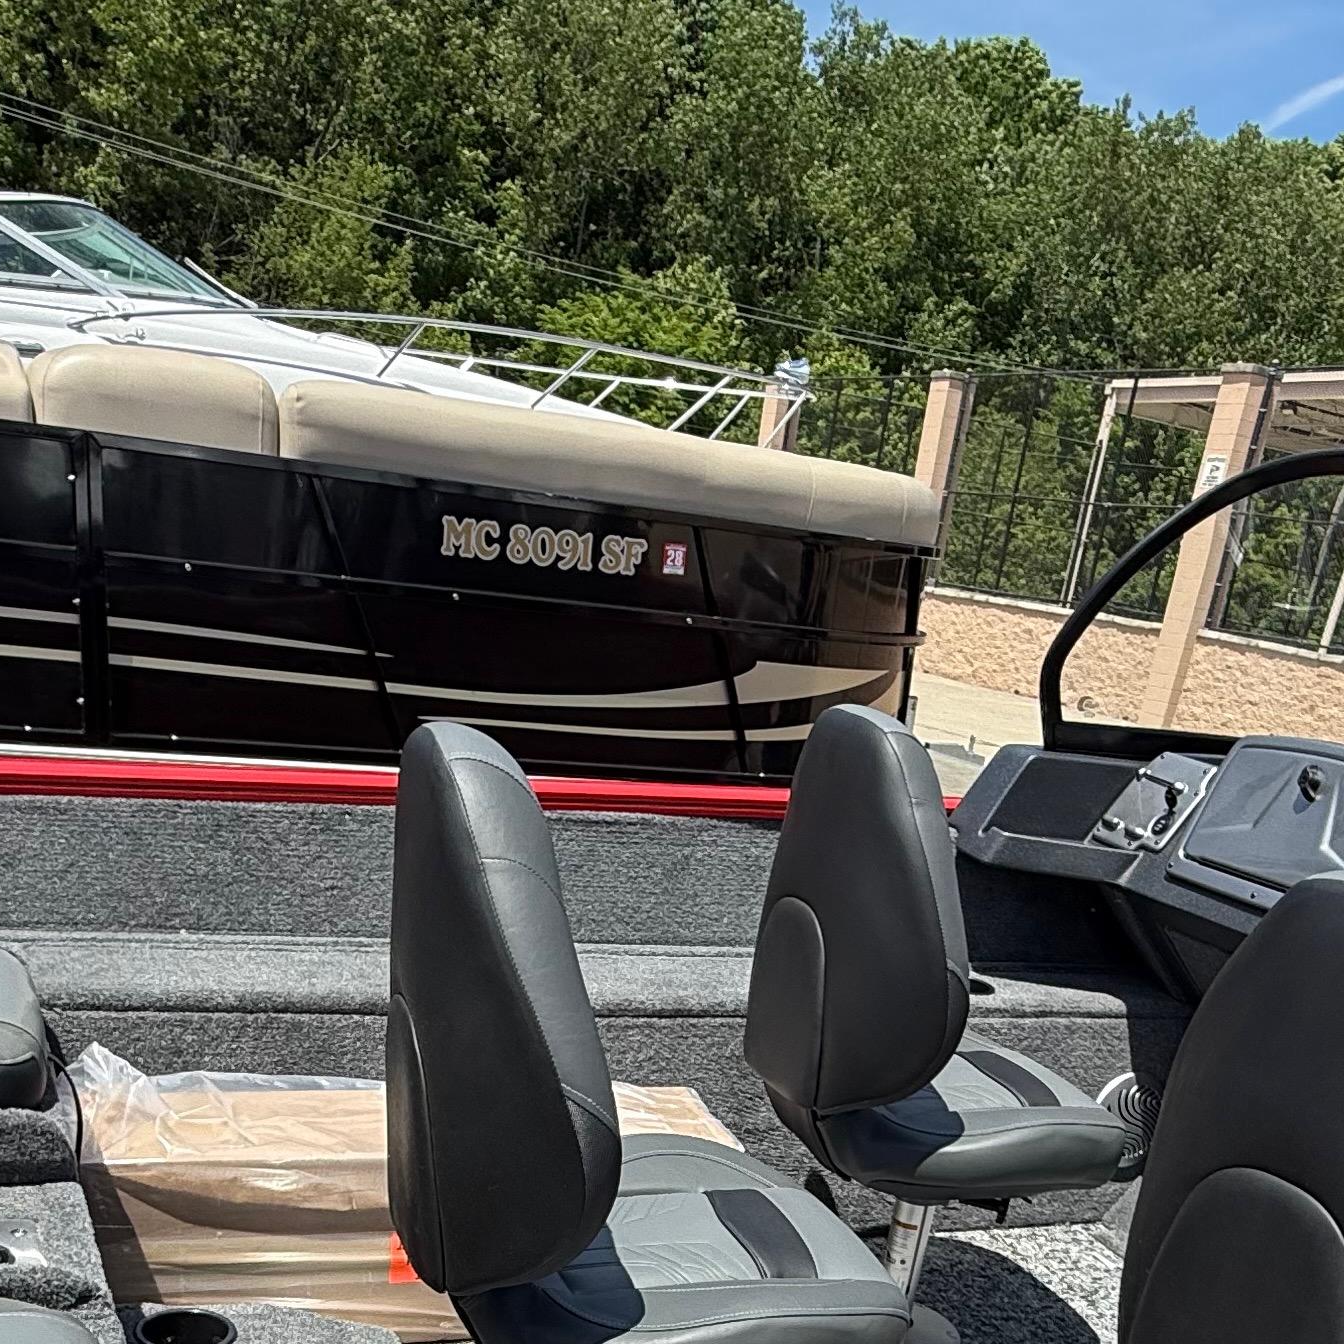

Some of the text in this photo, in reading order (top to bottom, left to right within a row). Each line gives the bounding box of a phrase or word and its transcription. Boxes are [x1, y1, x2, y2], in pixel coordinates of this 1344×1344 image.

[441, 515, 648, 576] MC 8091 SF
[666, 549, 684, 566] 28
